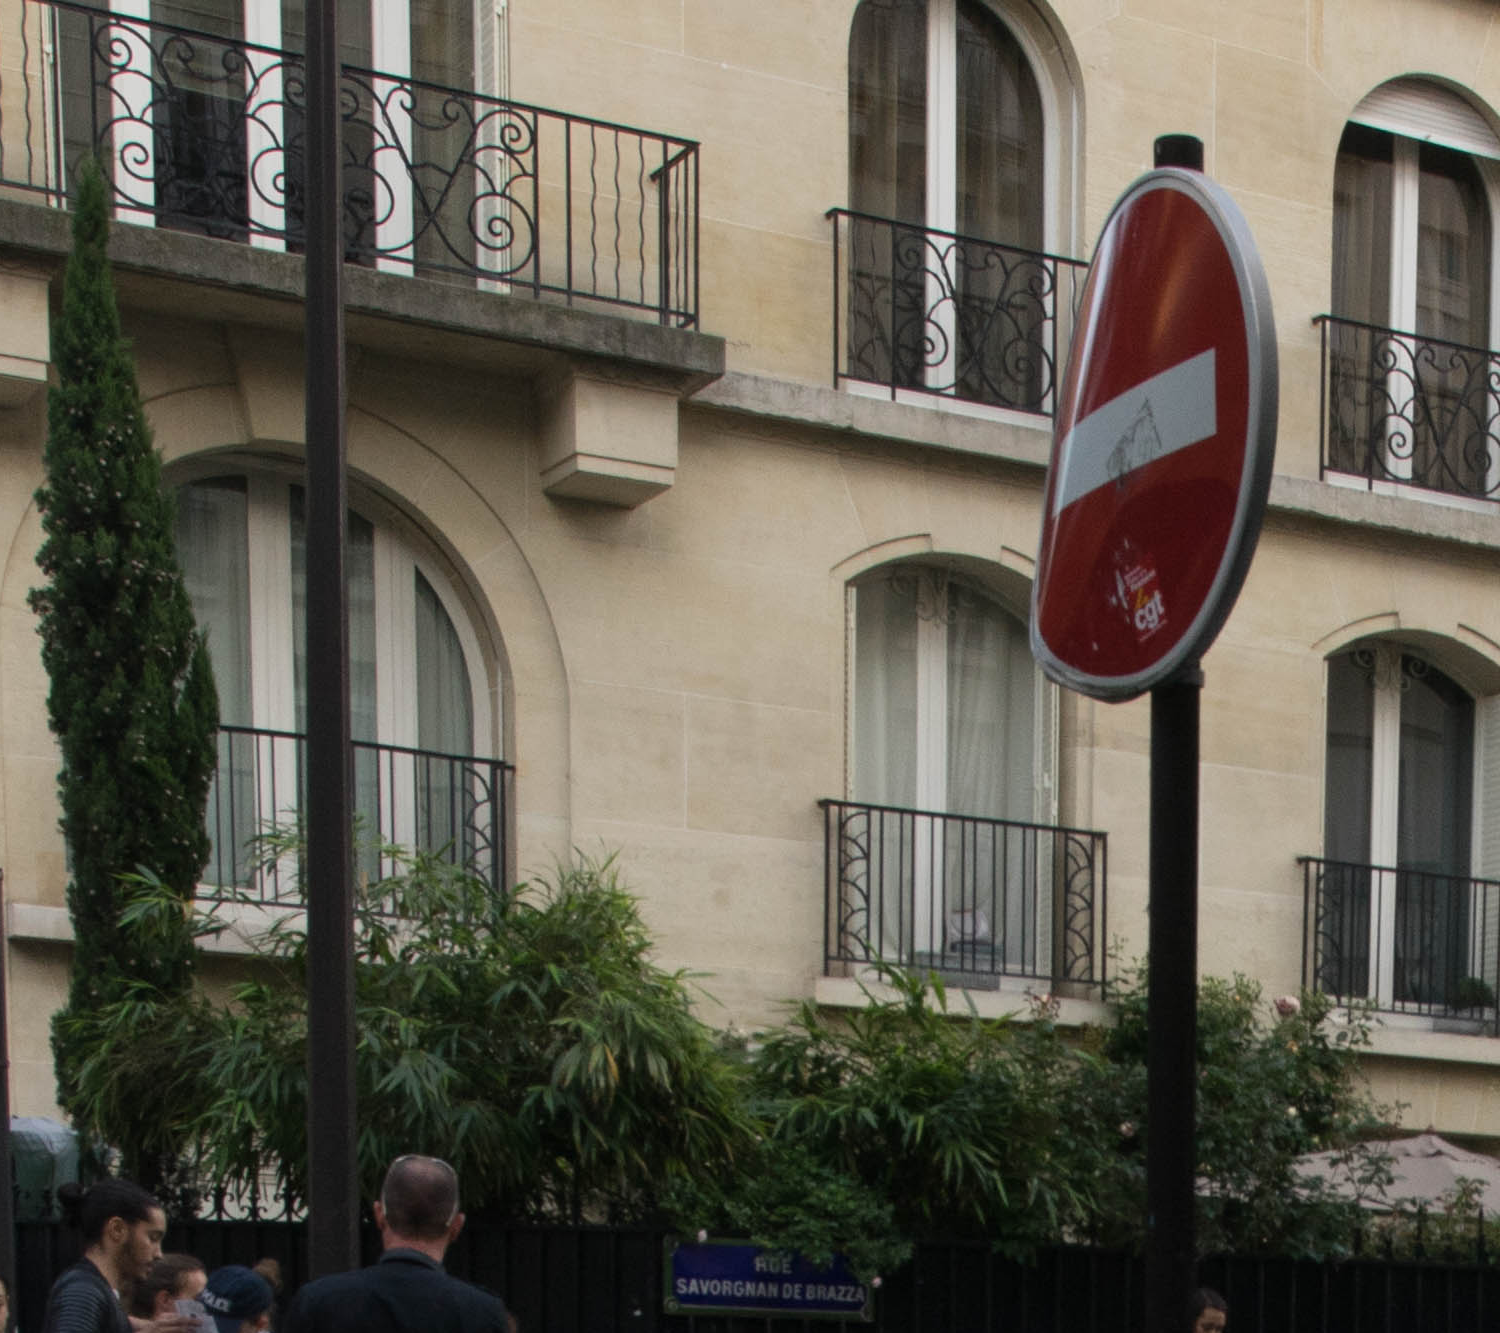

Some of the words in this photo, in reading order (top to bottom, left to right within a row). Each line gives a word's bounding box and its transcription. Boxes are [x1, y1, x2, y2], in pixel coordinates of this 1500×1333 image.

[1134, 589, 1165, 631] cgt
[753, 1254, 794, 1275] RUE
[675, 1276, 780, 1298] SAVORGNAN
[781, 1282, 804, 1299] DE
[805, 1283, 866, 1302] BRAZZA
